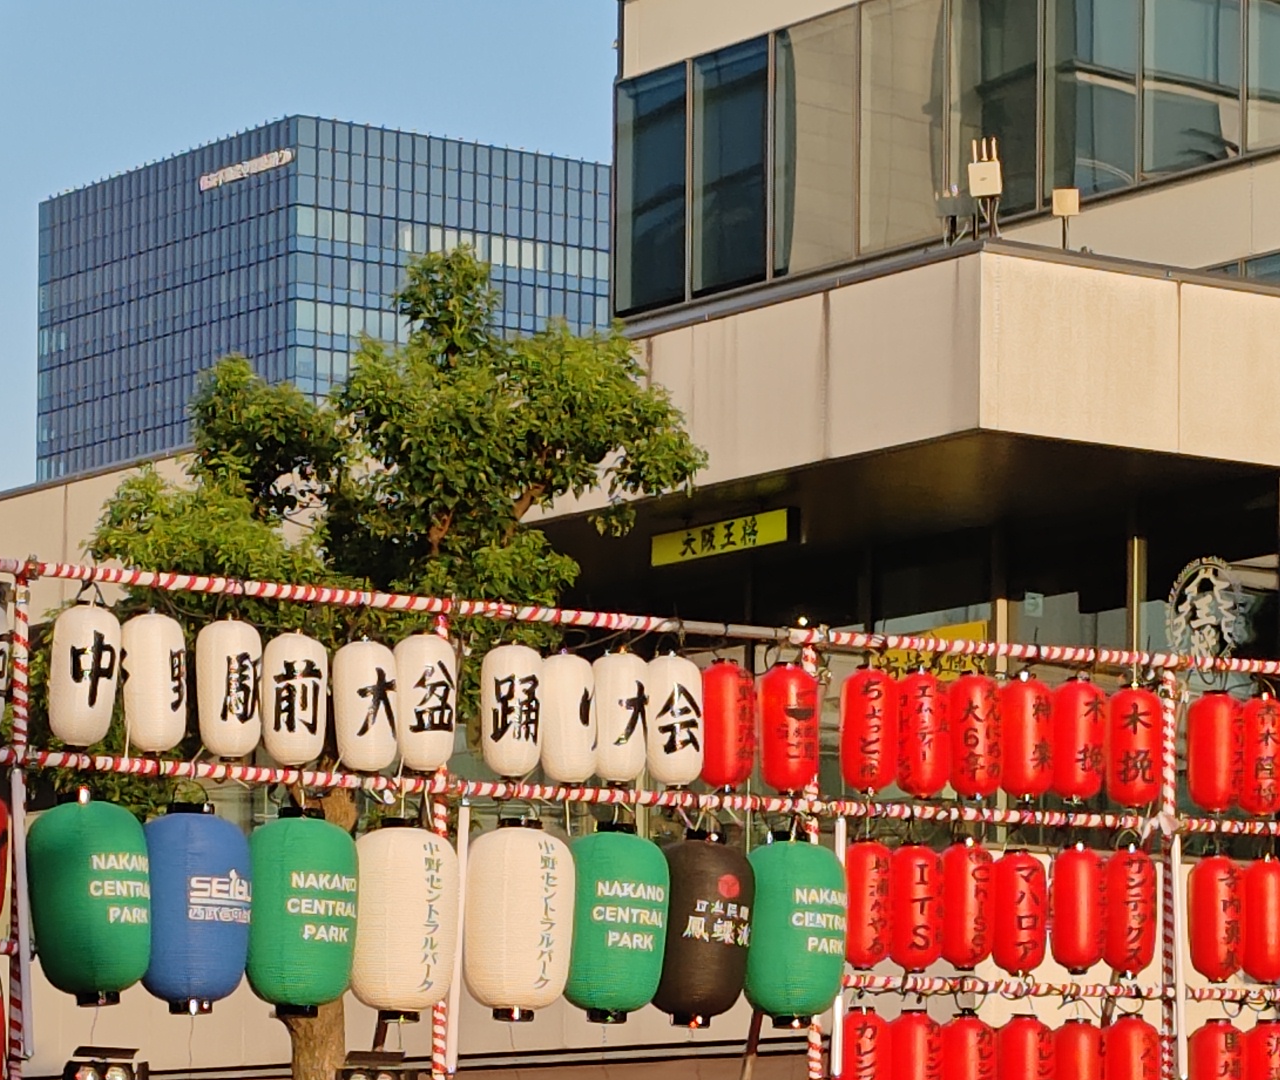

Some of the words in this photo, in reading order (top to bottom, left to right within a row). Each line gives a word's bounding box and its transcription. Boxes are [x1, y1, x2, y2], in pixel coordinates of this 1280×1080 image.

[678, 515, 759, 557] 大阪王将
[291, 872, 357, 893] NAKANO
[596, 880, 665, 902] NAKANO
[286, 898, 358, 919] CENTRAL
[533, 839, 559, 990] 中野セントラルパーク
[592, 906, 664, 928] CENTRAL
[910, 863, 933, 950] ITS
[302, 924, 348, 943] PARK
[607, 931, 654, 952] PARK
